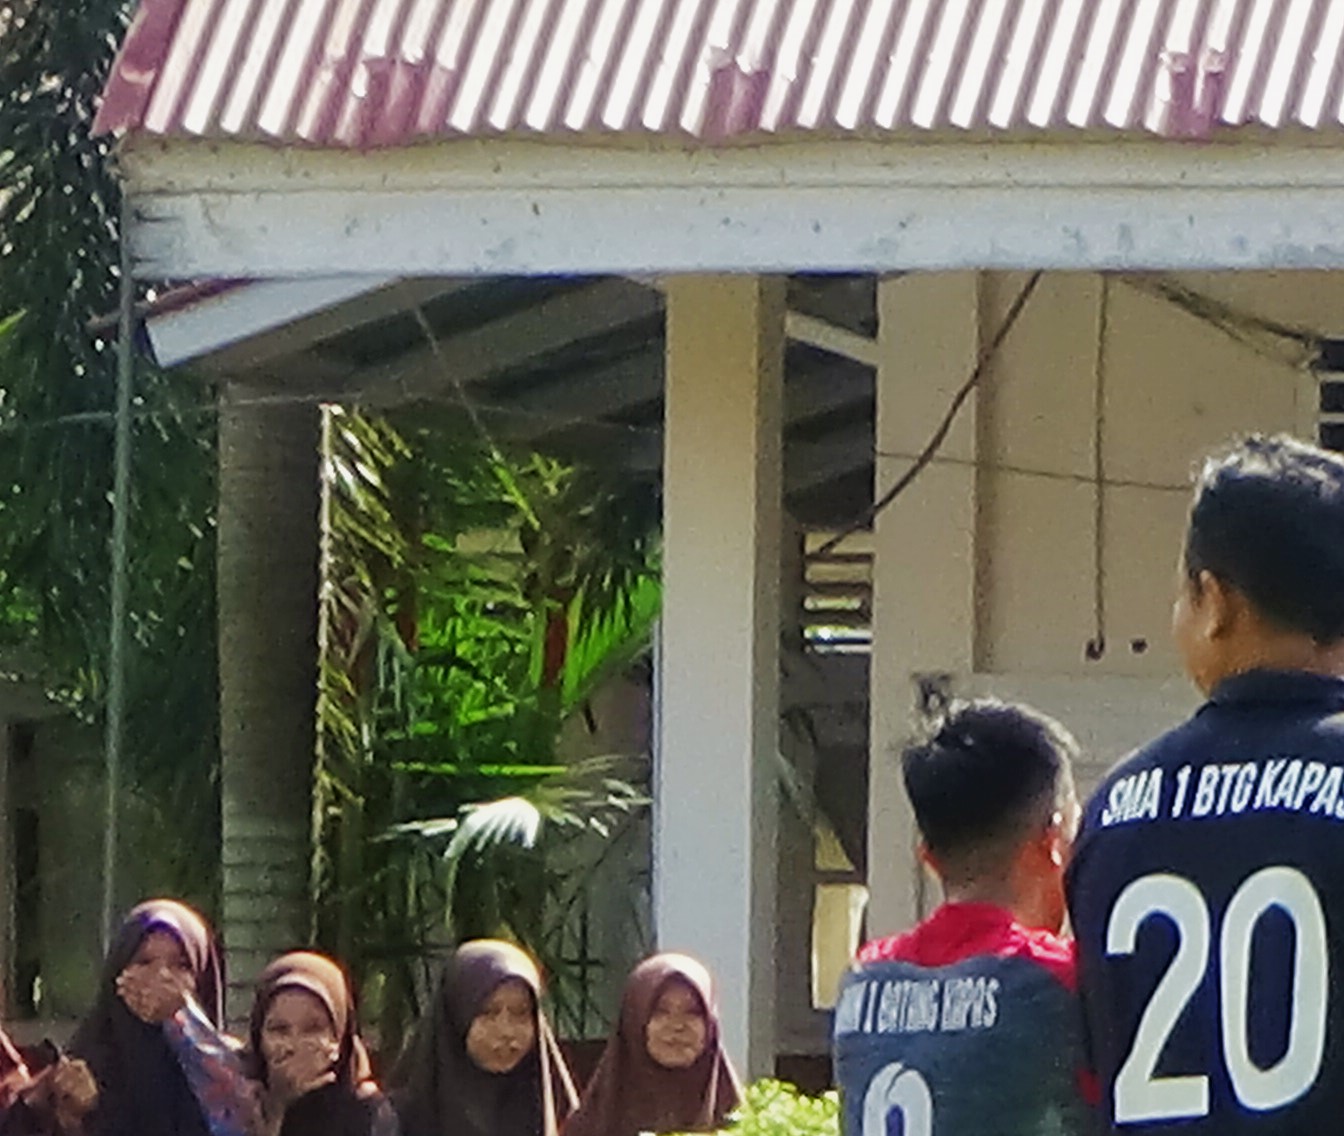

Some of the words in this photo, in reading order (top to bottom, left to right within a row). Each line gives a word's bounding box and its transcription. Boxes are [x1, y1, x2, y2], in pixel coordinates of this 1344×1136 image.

[1102, 768, 1162, 826] SMA
[1171, 764, 1192, 818] 1
[1192, 762, 1257, 817] BTG
[1106, 866, 1328, 1125] 20
